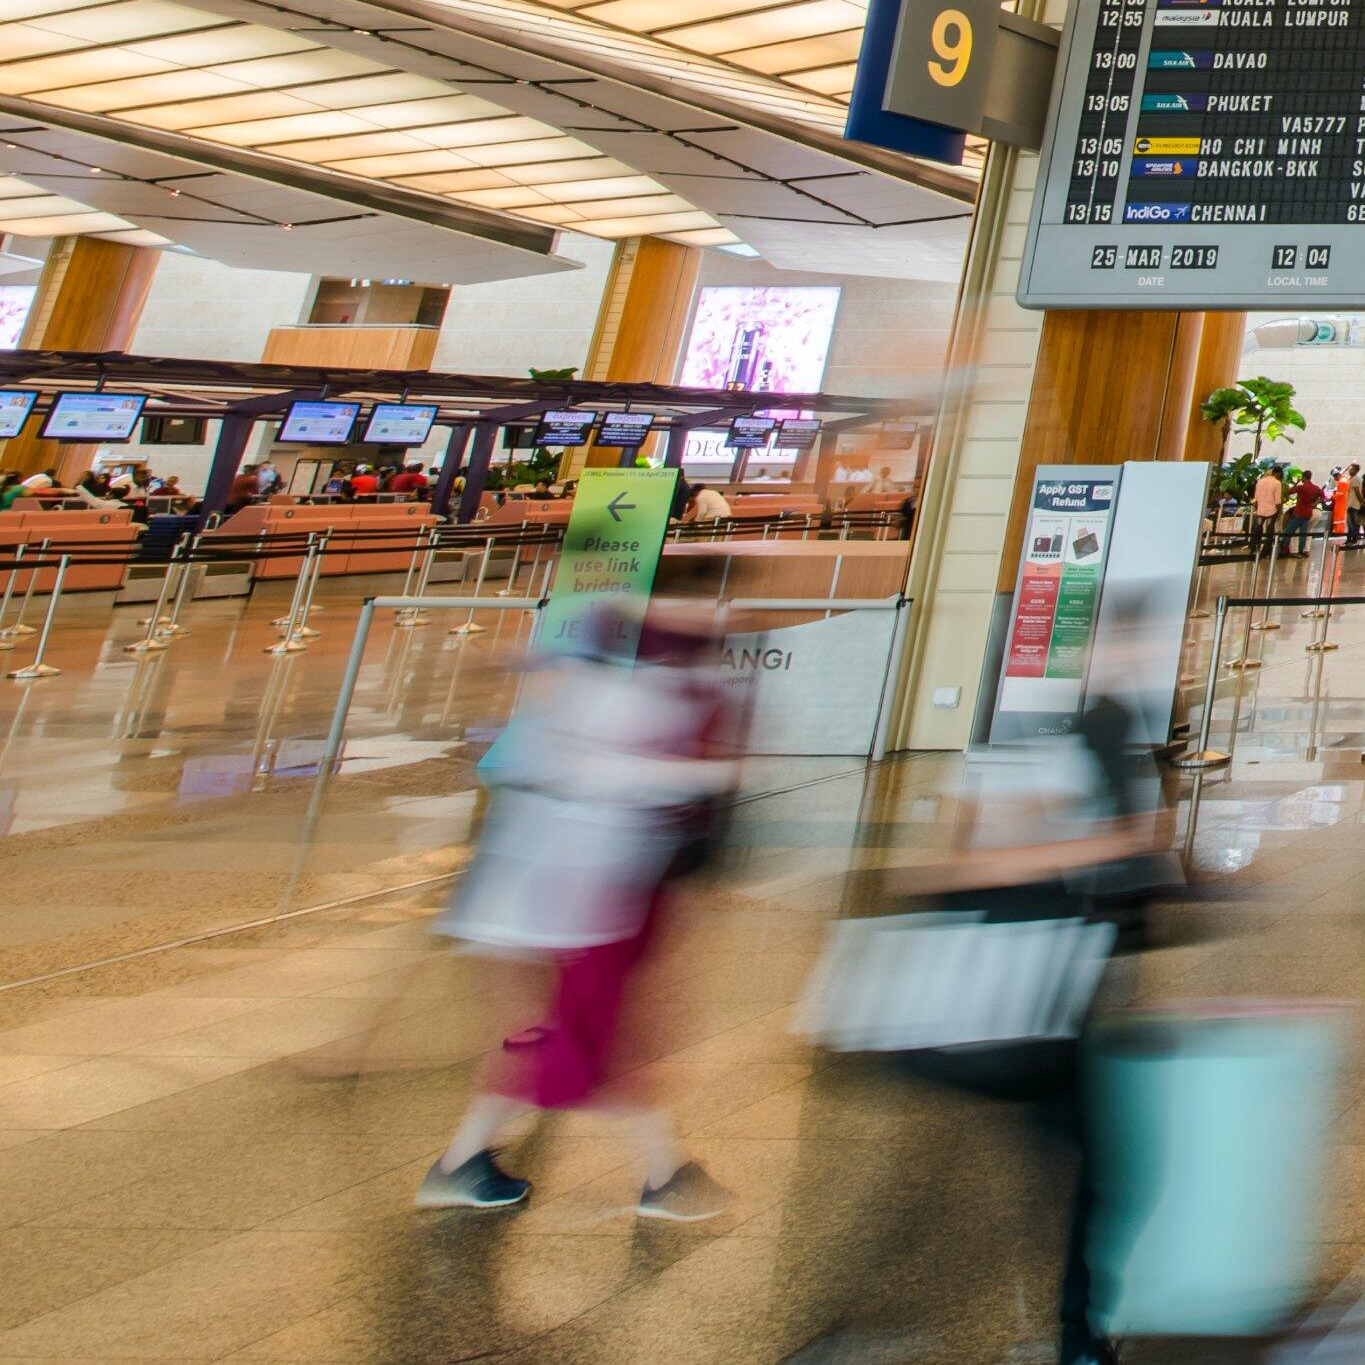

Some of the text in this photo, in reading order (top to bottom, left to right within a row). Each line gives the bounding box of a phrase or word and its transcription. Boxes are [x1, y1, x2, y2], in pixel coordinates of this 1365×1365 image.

[1220, 11, 1348, 26] KUALA LUMPUR
[928, 9, 973, 87] 9
[1214, 53, 1266, 69] DAVAO
[1207, 96, 1272, 111] PHUKET
[1201, 139, 1321, 154] HO CHI MINH
[1198, 160, 1318, 176] BANGKOK-BKK
[1127, 205, 1170, 219] IndiGo
[1191, 205, 1265, 221] CHENNAI
[1138, 276, 1164, 286] DATE
[1268, 276, 1327, 286] LOCAL TIME
[1039, 485, 1089, 495] Apply GST
[1052, 497, 1087, 507] Refund
[584, 538, 640, 552] Please
[573, 558, 640, 572] use link
[573, 578, 631, 594] bridge
